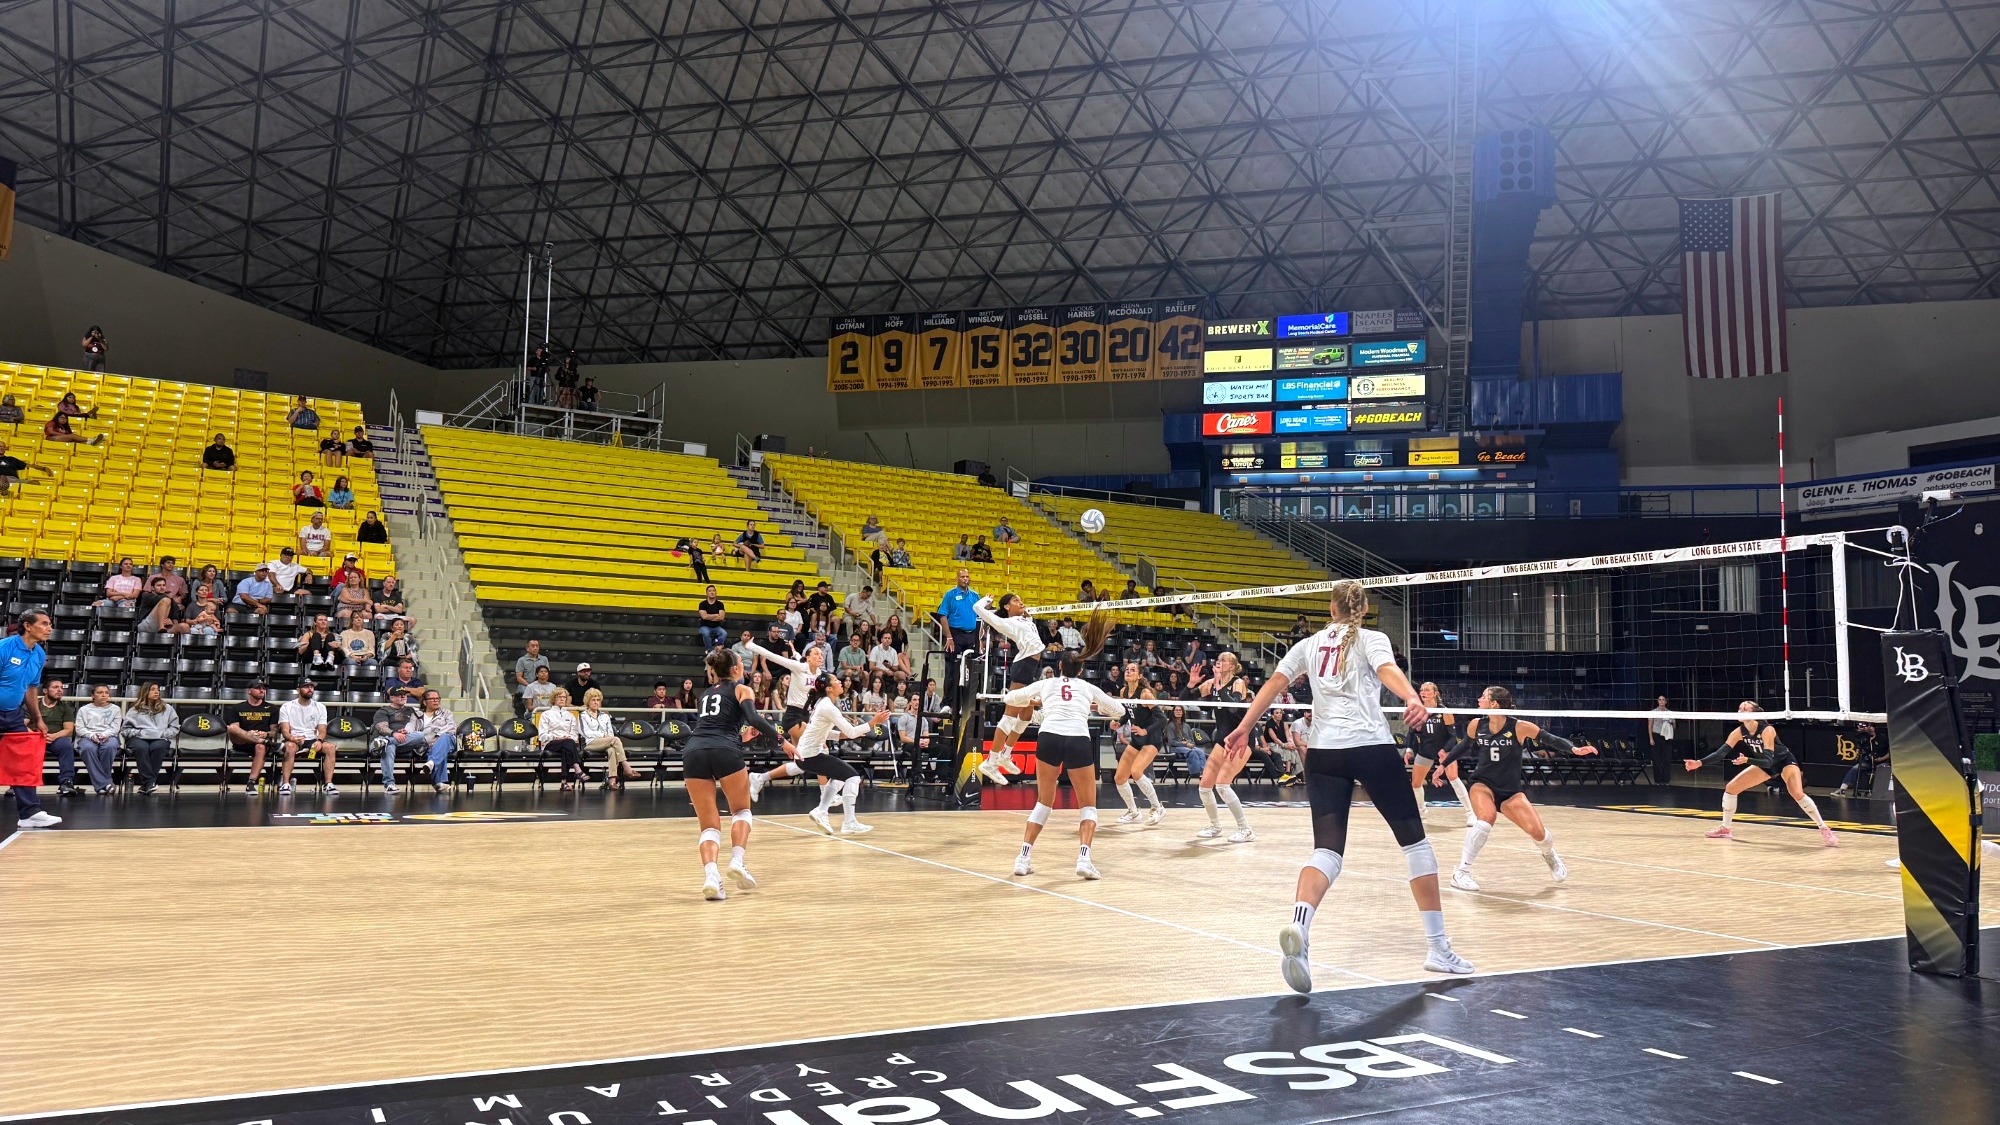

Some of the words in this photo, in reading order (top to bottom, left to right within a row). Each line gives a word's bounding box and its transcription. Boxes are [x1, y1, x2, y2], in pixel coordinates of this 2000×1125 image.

[1067, 310, 1095, 319] HARRIS
[1108, 307, 1153, 317] MCDONALD
[1165, 304, 1197, 314] RATLEFF
[923, 318, 956, 326] HILLIARD
[968, 315, 1004, 324] WINSLOW
[1018, 313, 1049, 321] RUSSELL
[1355, 318, 1393, 327] ISLAND
[836, 322, 865, 330] LOTMAN
[885, 320, 904, 328] HOFF
[1288, 323, 1337, 331] MemorialCare
[1060, 329, 1100, 365] 30
[1109, 327, 1150, 364] 20
[1157, 324, 1201, 361] 42
[884, 339, 903, 373] 9
[930, 337, 948, 371] 7
[971, 335, 1000, 369] 15
[1012, 332, 1052, 367] 32
[840, 341, 859, 375] 2
[1282, 382, 1296, 390] LBS
[1296, 380, 1333, 390] Financial
[1216, 413, 1259, 433] Cane's
[1354, 412, 1422, 424] #GOBEACH
[1477, 451, 1491, 461] Go
[1494, 451, 1526, 460] Beach
[1926, 467, 1992, 483] #GOBEACH
[1802, 484, 1844, 499] GLENN
[1846, 483, 1857, 494] E.
[1862, 475, 1918, 492] THOMAS
[1923, 479, 1992, 493] getdodge.com
[307, 533, 325, 541] LMU
[1691, 546, 1710, 557] LONG
[1712, 544, 1737, 555] BEACH
[1738, 541, 1761, 553] STATE
[1591, 556, 1609, 566] LONG
[1610, 554, 1632, 565] BEACH
[1632, 552, 1654, 562] STATE
[1503, 565, 1519, 574] LONG
[1519, 563, 1539, 572] BEACH
[1539, 562, 1558, 570] STATE
[1369, 577, 1384, 586] BEACH
[1384, 576, 1399, 584] STATE
[1425, 572, 1439, 581] LONG
[1439, 571, 1456, 580] BEACH
[1456, 569, 1473, 579] STATE
[1894, 646, 1929, 684] LB
[1060, 685, 1073, 701] 6
[699, 693, 721, 718] 13
[1425, 724, 1434, 734] 11
[1478, 738, 1513, 746] BEACH
[1750, 743, 1764, 753] 77
[1490, 747, 1500, 762] 6
[1223, 1033, 1517, 1091] LBS
[657, 1070, 948, 1116] CREDIT
